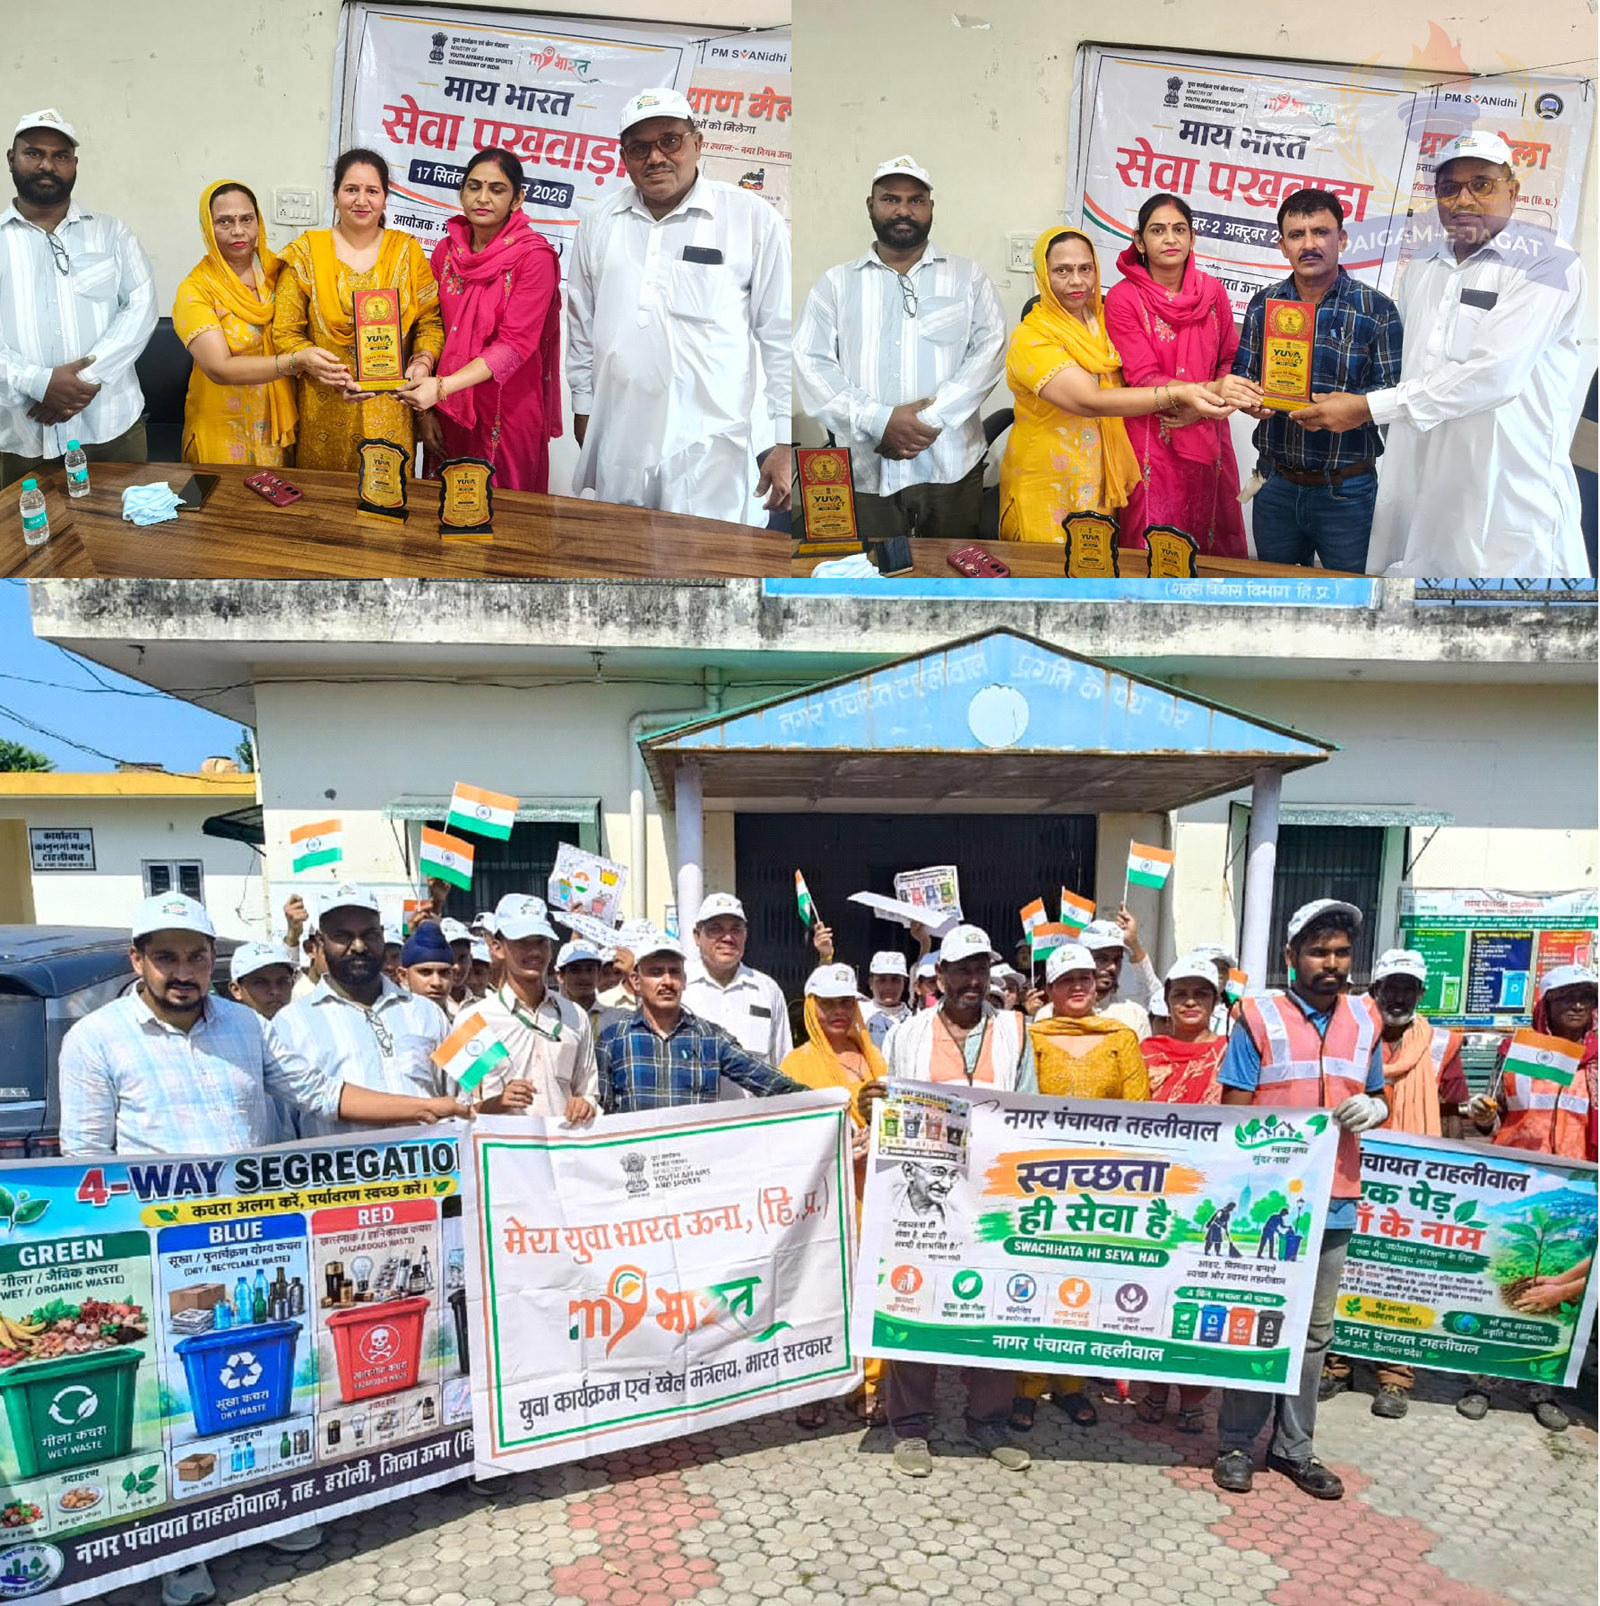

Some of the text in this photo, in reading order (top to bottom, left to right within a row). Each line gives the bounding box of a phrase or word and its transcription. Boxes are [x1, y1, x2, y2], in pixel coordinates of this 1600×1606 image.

[448, 59, 479, 68] GOVERNMENT
[450, 52, 465, 60] YOUTH
[466, 54, 484, 62] AFFAIRS
[711, 48, 728, 57] PM
[444, 76, 575, 117] माय भारत
[1184, 103, 1214, 112] GOVERNMENT
[1185, 96, 1200, 104] YOUTH
[1201, 98, 1218, 106] AFFAIRS
[1445, 93, 1461, 103] PM
[381, 94, 465, 152] सेवा
[723, 121, 756, 134] मिलेगा
[1180, 119, 1310, 160] माय भारत
[1116, 137, 1200, 195] सेवा
[416, 166, 429, 180] 17
[532, 185, 567, 203] 2026
[393, 214, 433, 231] आयोजक
[1224, 222, 1267, 243] अक्टूबर
[367, 334, 391, 343] YUVA
[1273, 349, 1301, 359] YUVA
[814, 495, 842, 503] YUVA
[1080, 666, 1103, 700] के
[1004, 1106, 1222, 1142] नगर पंचायत तहलीवाल
[77, 1160, 225, 1206] 4-WAY
[655, 1181, 672, 1189] AND
[1016, 1159, 1171, 1194] स्वच्छता
[1425, 1161, 1530, 1192] टाहलीवाल
[192, 1181, 428, 1218] कचरा अलग करें, पर्यावरण स्वच्छ करें।
[1409, 1180, 1456, 1220] पेड़
[358, 1206, 394, 1226] RED
[1018, 1193, 1172, 1239] ही सेवा है
[209, 1221, 263, 1244] BLUE
[504, 1216, 559, 1255] मेरा
[563, 1225, 610, 1264] युवा
[614, 1213, 682, 1246] भारत
[683, 1204, 752, 1236] ऊना,
[1380, 1207, 1486, 1250] के नाम
[18, 1239, 104, 1267] GREEN
[168, 1254, 193, 1268] सूखा
[1014, 1241, 1160, 1263] SWACHHATA HI SEVA HAI
[2, 1264, 118, 1288] गीला जैविक कचरा
[211, 1258, 259, 1272] RECYCLABLE
[35, 1280, 83, 1295] ORGANIC
[86, 1275, 124, 1289] WASTE)
[992, 1334, 1165, 1361] नागर पंचायत तहलीवाल
[1344, 1325, 1370, 1339] नगर
[1419, 1336, 1480, 1356] टाहलीवाल
[519, 1397, 549, 1431] युवा
[553, 1375, 621, 1413] कार्यक्रम
[625, 1372, 651, 1402] एवं
[655, 1372, 686, 1394] खेल
[745, 1348, 780, 1382] भारत
[783, 1336, 834, 1365] सरकार
[242, 1390, 269, 1402] कचरा
[221, 1404, 266, 1420] DRY WASTE
[42, 1425, 107, 1448] गीला कचरा
[48, 1440, 103, 1459] WET WASTE
[60, 1469, 99, 1484] उदाहरण
[75, 1534, 119, 1566] नगर
[123, 1513, 188, 1552] पंचायत
[193, 1488, 288, 1529] टाहलीवाल,
[291, 1479, 321, 1504] तह.
[325, 1463, 377, 1491] हरोली,
[379, 1446, 418, 1475] जिला
[420, 1442, 451, 1466] ऊना
